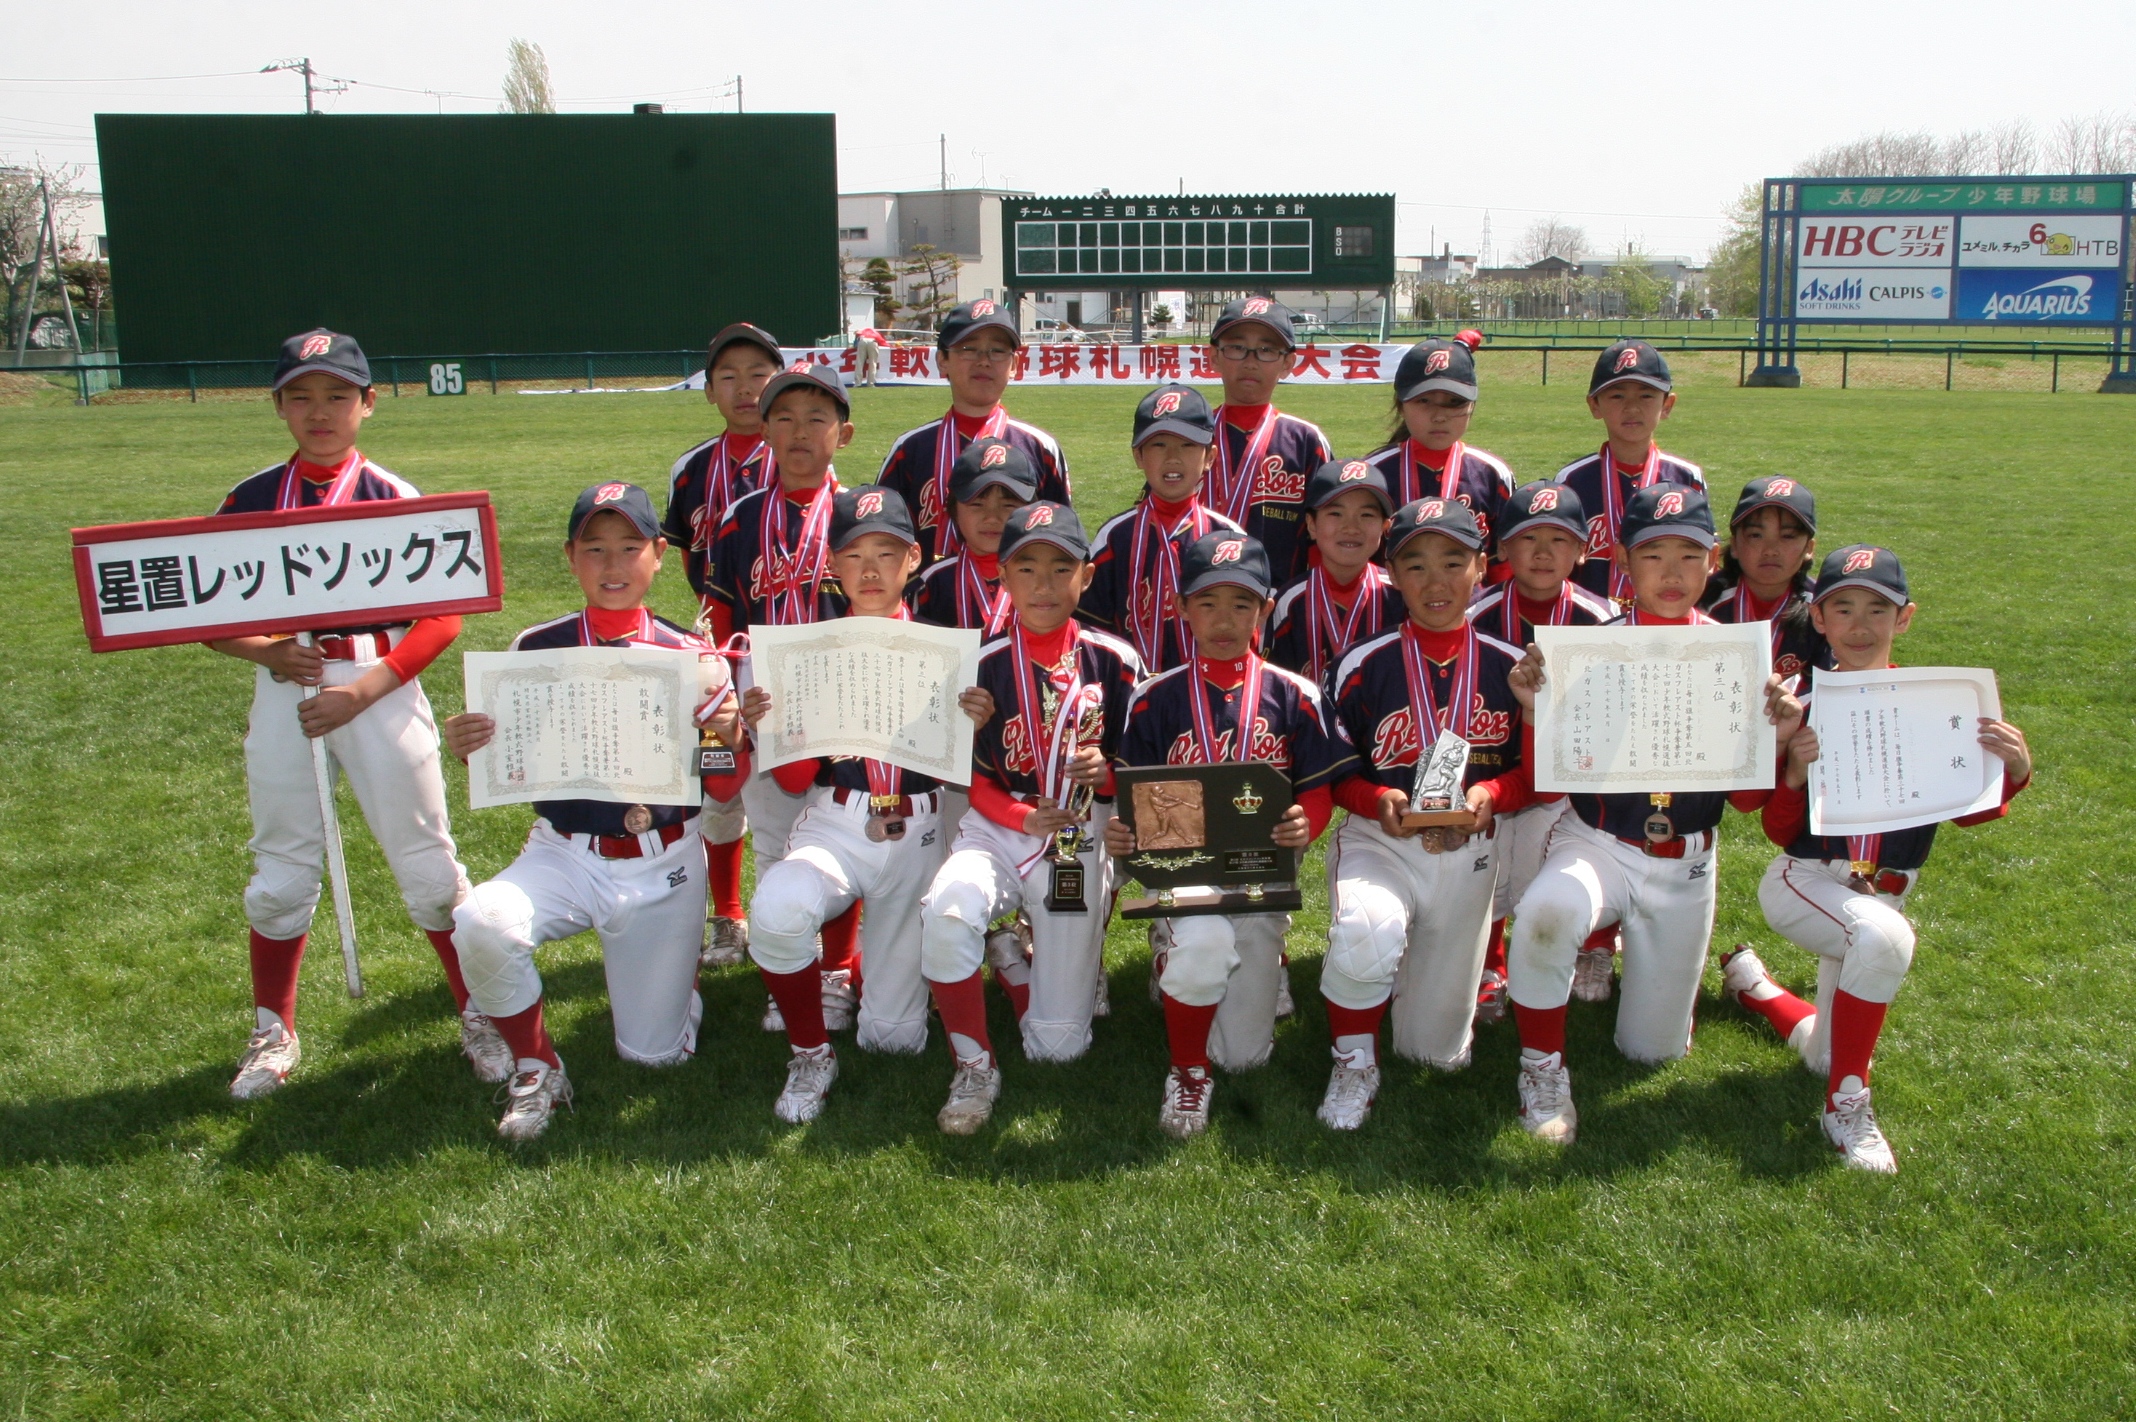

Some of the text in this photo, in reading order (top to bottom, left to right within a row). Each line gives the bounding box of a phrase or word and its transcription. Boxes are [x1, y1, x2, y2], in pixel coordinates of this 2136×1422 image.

[1020, 206, 1053, 217] チーム
[1083, 207, 1093, 216] 二
[1104, 207, 1114, 216] 三
[1125, 206, 1136, 216] 四
[1147, 206, 1157, 216] 五
[1168, 206, 1179, 216] 六
[1190, 206, 1201, 216] 七
[1211, 206, 1222, 216] 八
[1232, 205, 1243, 216] 九
[1254, 205, 1265, 216] 十
[1275, 204, 1305, 216] 合計
[1803, 225, 1896, 257] HBC
[1900, 225, 1948, 240] テレビ
[2029, 223, 2047, 244] 6
[1898, 243, 1945, 257] ラジオ
[2077, 240, 2118, 256] HTB
[1799, 277, 1862, 301] Asahi
[1869, 286, 1924, 301] CALPIS
[1982, 289, 2092, 320] AQUARIUS
[300, 334, 332, 360] R
[430, 363, 463, 396] 85
[98, 530, 483, 615] 星置レッドソックス
[1234, 661, 1244, 672] 10
[1712, 662, 1725, 701] 第三位
[928, 680, 940, 723] 表彰状
[1729, 681, 1742, 734] 表彰状
[652, 705, 665, 754] 表彰状
